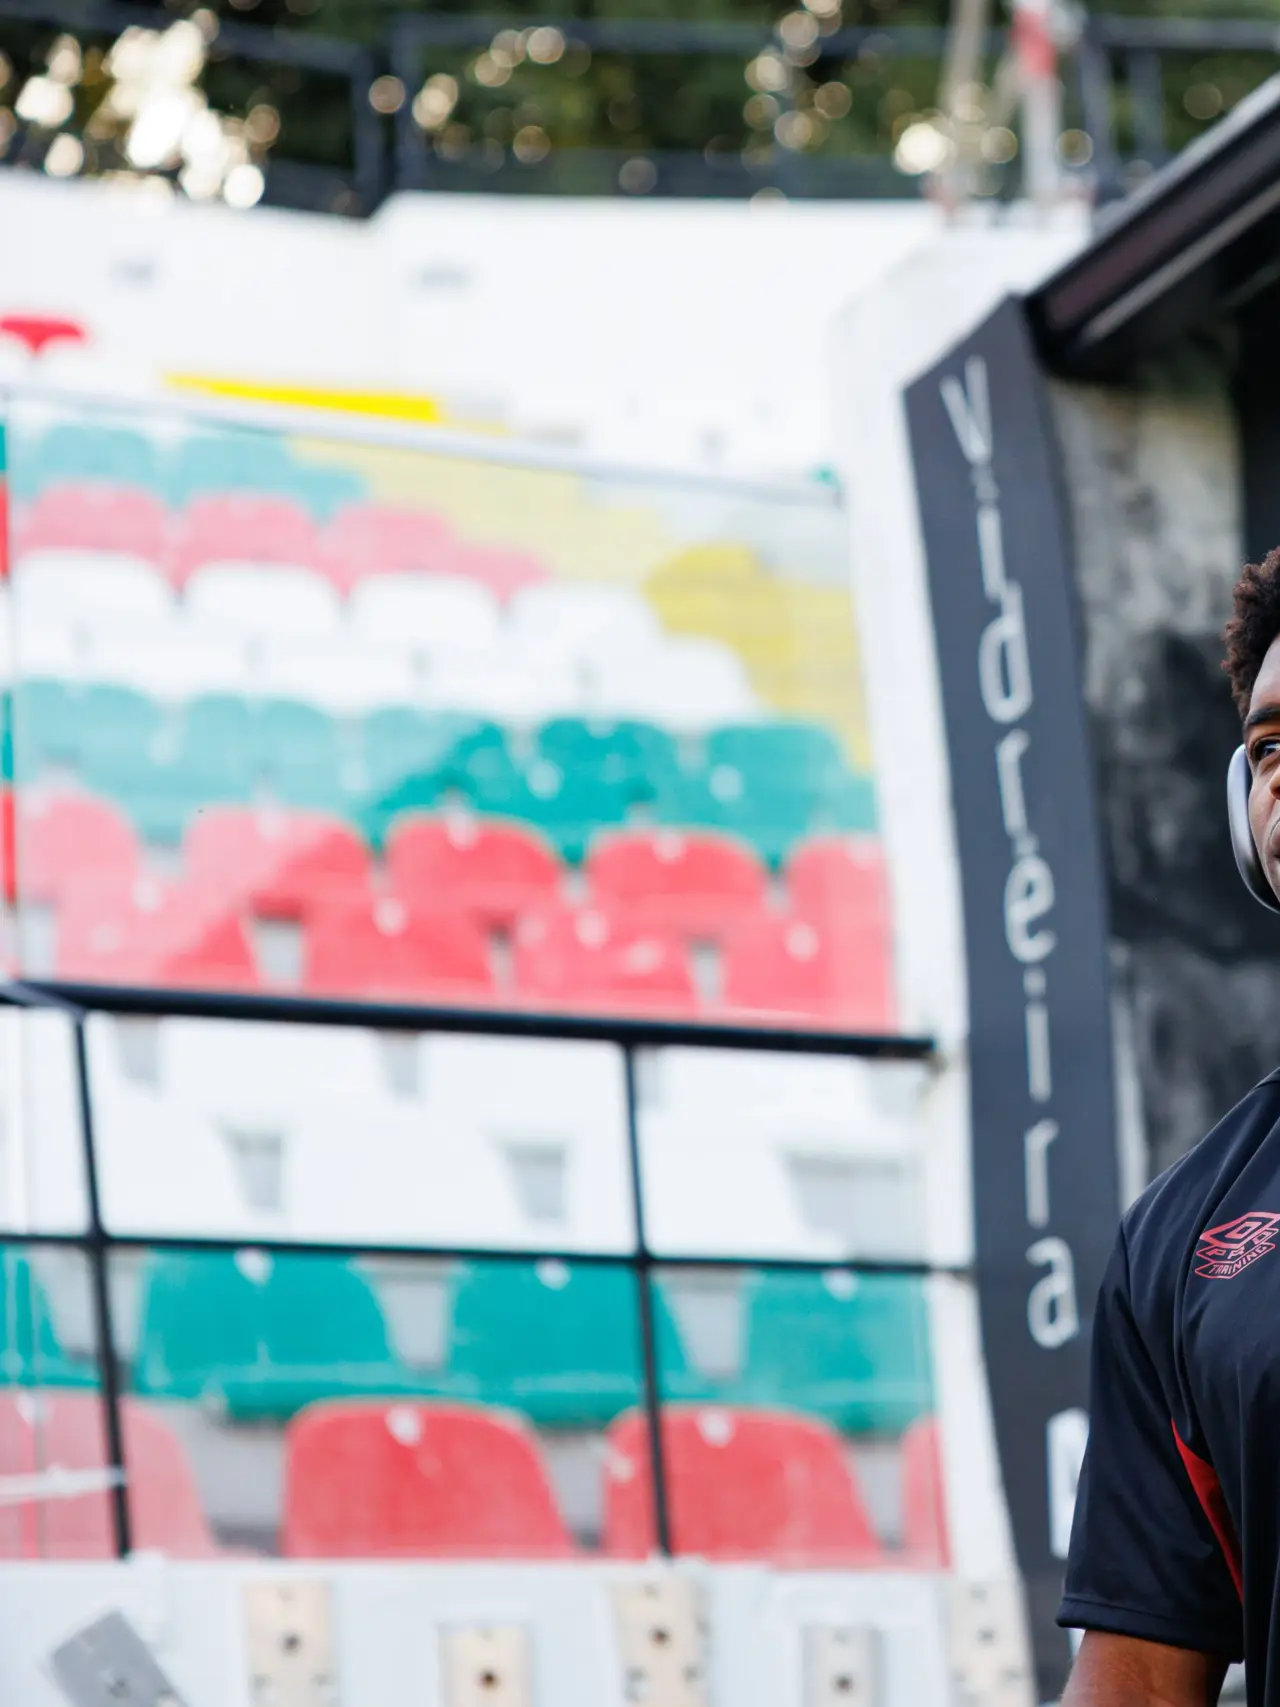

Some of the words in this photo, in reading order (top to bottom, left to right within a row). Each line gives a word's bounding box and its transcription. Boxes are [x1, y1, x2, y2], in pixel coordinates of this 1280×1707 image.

[939, 354, 1079, 1349] vidreira
[1205, 1230, 1273, 1260] PRO
[1208, 1244, 1268, 1275] TRAINING
